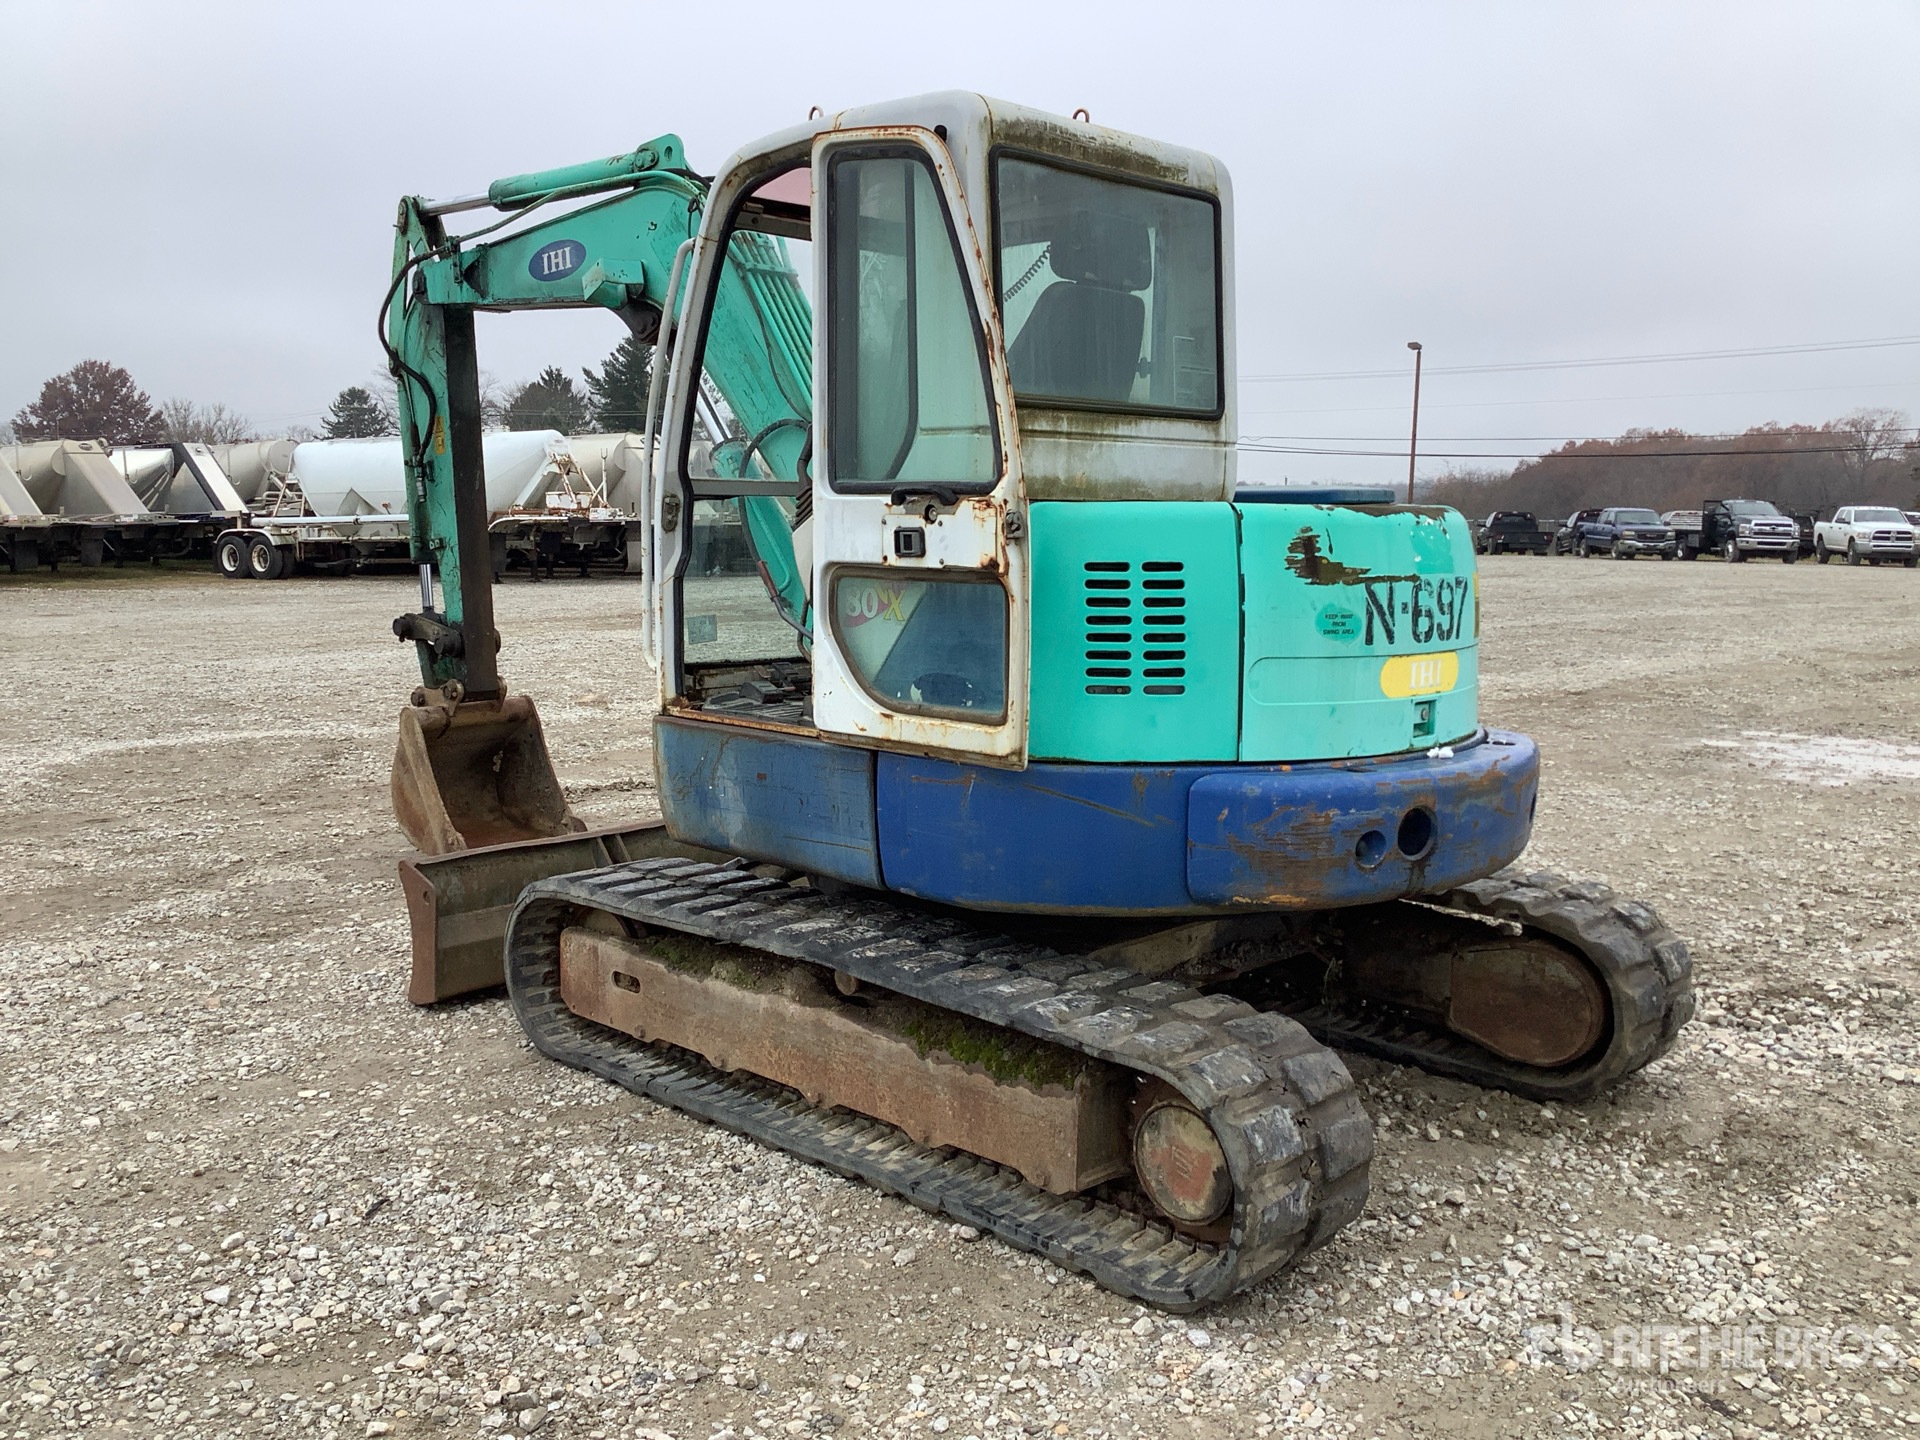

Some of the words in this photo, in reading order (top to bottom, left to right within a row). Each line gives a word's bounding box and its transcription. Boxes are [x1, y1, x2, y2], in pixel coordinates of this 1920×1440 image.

[541, 246, 572, 275] IHI
[1364, 577, 1468, 646] N-697
[1409, 659, 1442, 690] IHI
